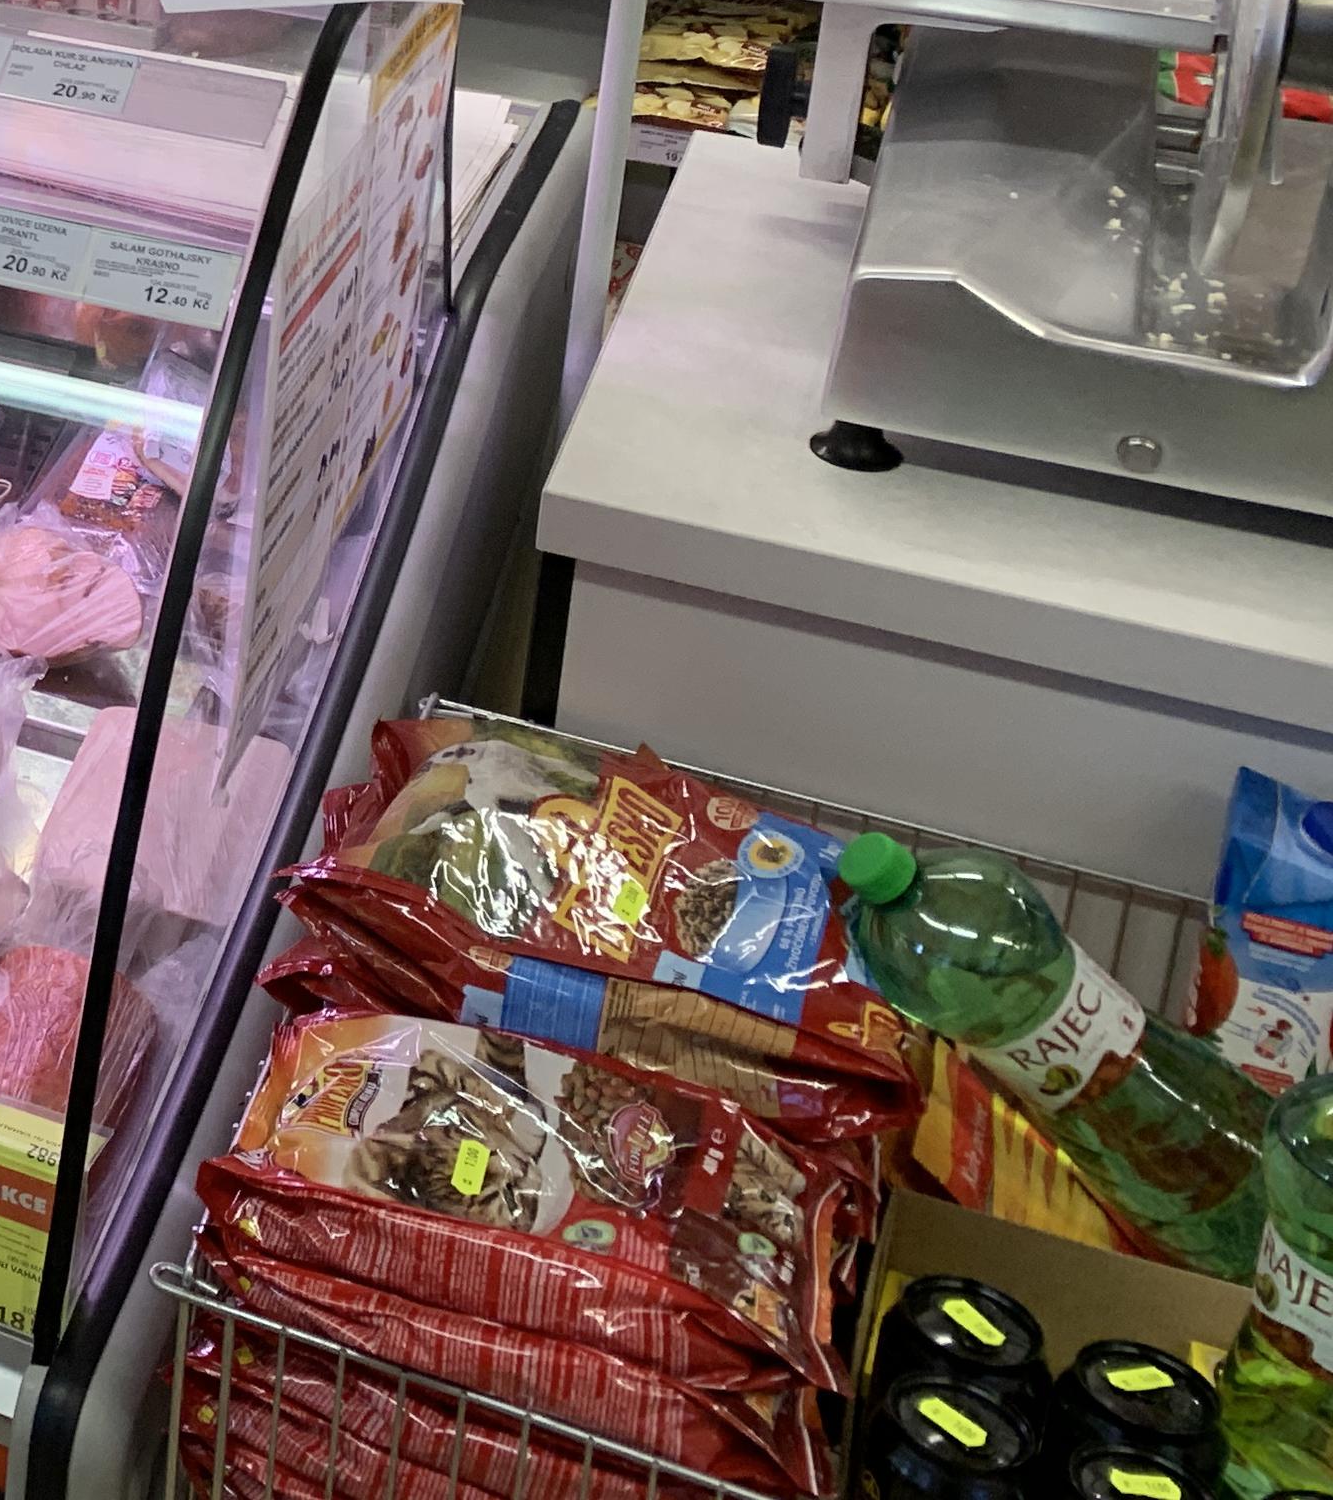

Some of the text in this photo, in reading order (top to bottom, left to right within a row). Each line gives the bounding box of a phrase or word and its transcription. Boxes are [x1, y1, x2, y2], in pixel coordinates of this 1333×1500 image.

[109, 240, 145, 256] SALAM
[135, 256, 181, 272] KRASNO
[1007, 983, 1102, 1071] RAJEC
